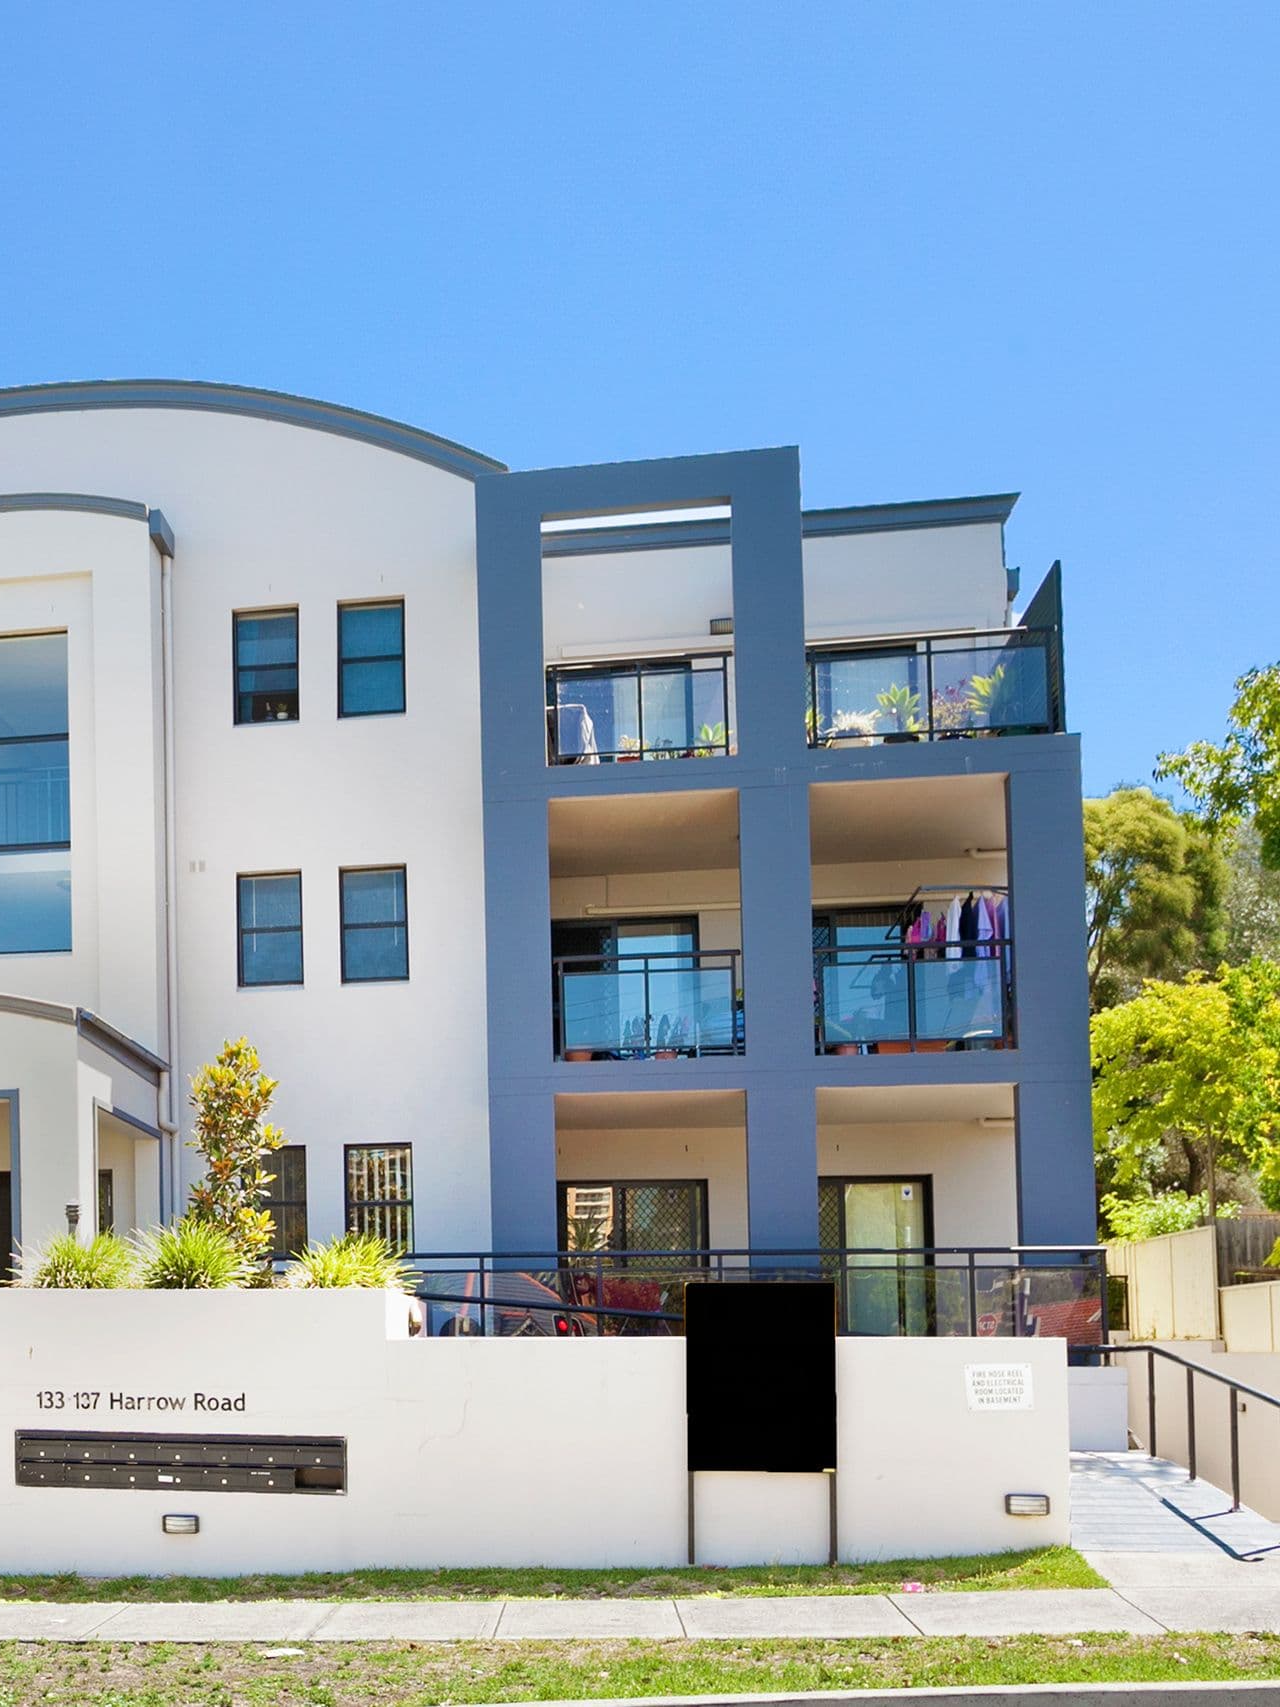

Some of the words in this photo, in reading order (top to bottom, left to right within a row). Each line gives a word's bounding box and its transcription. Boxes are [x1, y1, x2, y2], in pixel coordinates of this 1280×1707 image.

[988, 1370, 1005, 1378] HOSE
[986, 1378, 1024, 1386] ELECTRICAL
[994, 1387, 1024, 1395] LOCATED
[109, 1392, 186, 1410] Harrow
[194, 1392, 246, 1411] Road
[986, 1396, 1022, 1404] BASEMENT
